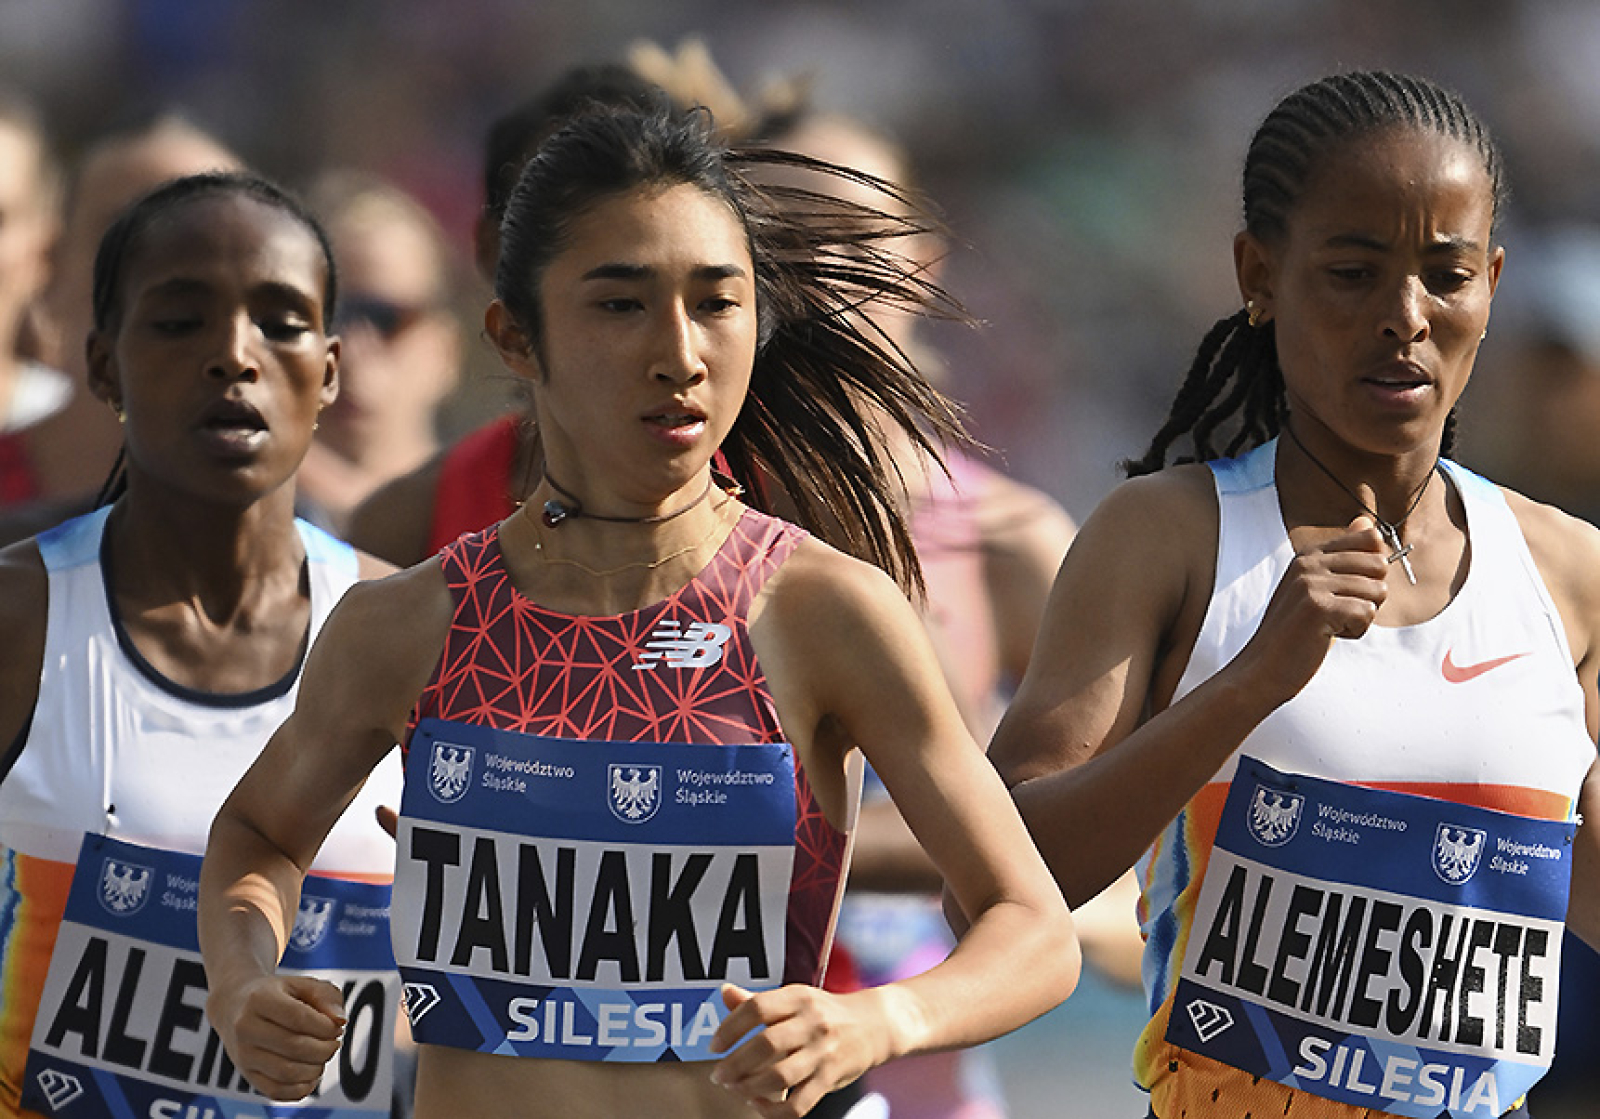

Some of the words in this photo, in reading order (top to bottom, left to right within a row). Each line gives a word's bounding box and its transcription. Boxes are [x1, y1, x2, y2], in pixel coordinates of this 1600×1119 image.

[485, 752, 575, 778] Województwo
[676, 769, 775, 787] Województwo
[676, 785, 727, 807] Śląskie
[1317, 802, 1408, 832] Województwo
[411, 825, 770, 983] TANAKA
[1194, 863, 1550, 1057] ALEMESHETE
[506, 997, 720, 1047] SILESIA
[1293, 1035, 1500, 1118] SILESIA
